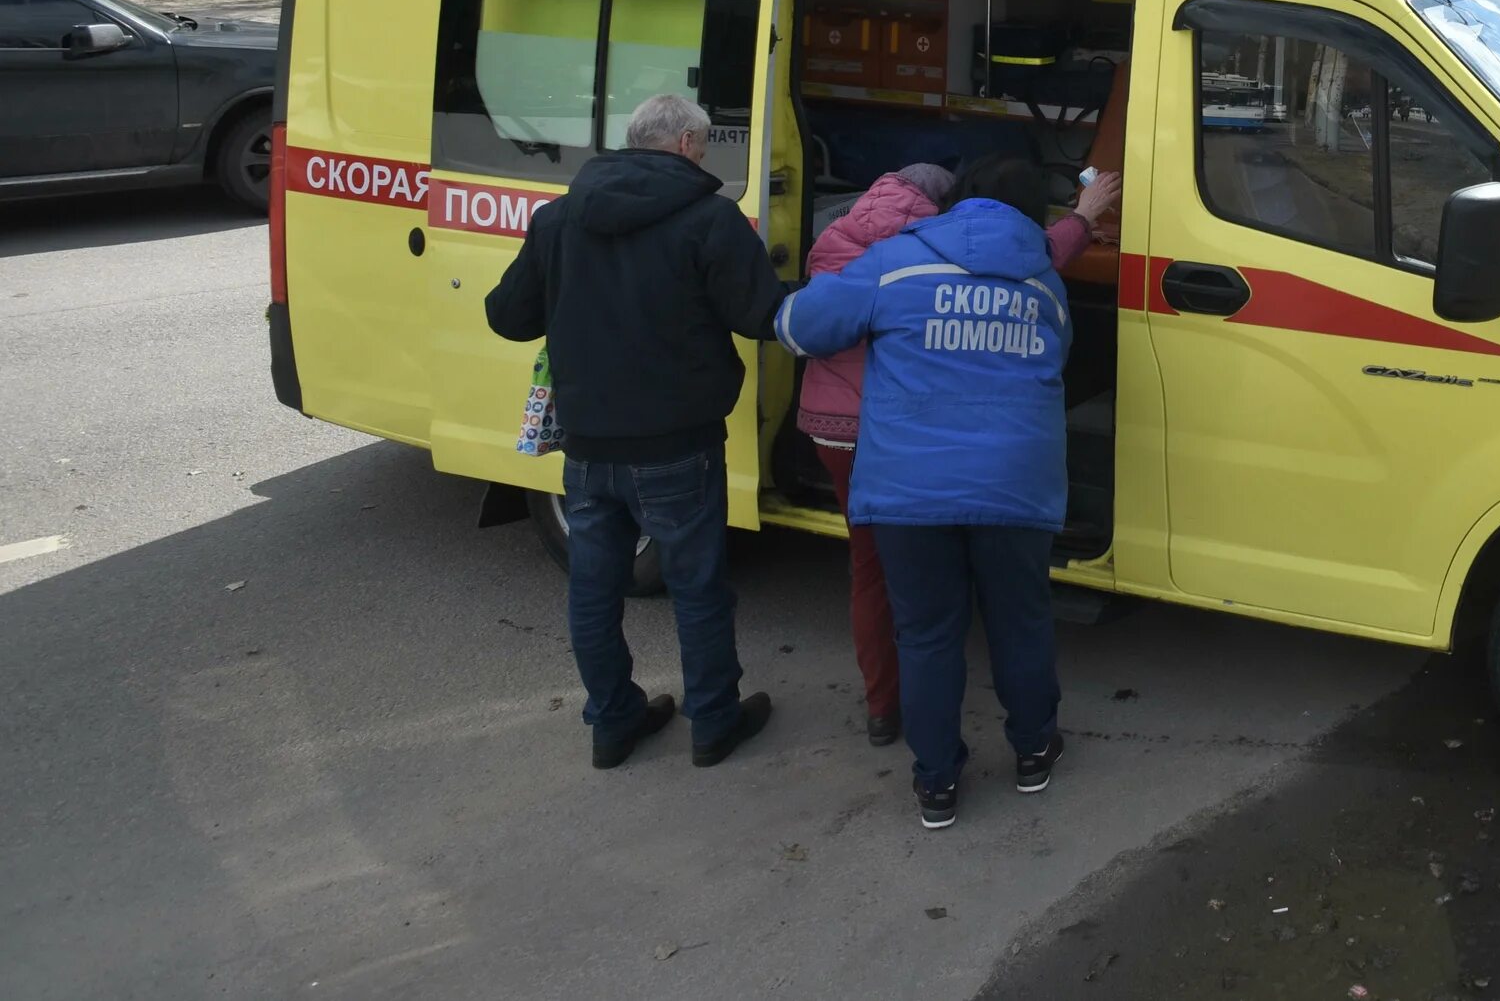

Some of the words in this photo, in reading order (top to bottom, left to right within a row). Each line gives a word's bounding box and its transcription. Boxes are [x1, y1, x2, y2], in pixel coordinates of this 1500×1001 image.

[306, 156, 431, 202] СКОРАЯ
[445, 188, 551, 232] ПОМ
[934, 284, 1039, 324] СКОРАЯ
[924, 318, 1046, 359] ПОМОЩЬ
[1362, 364, 1474, 387] GAZelle
